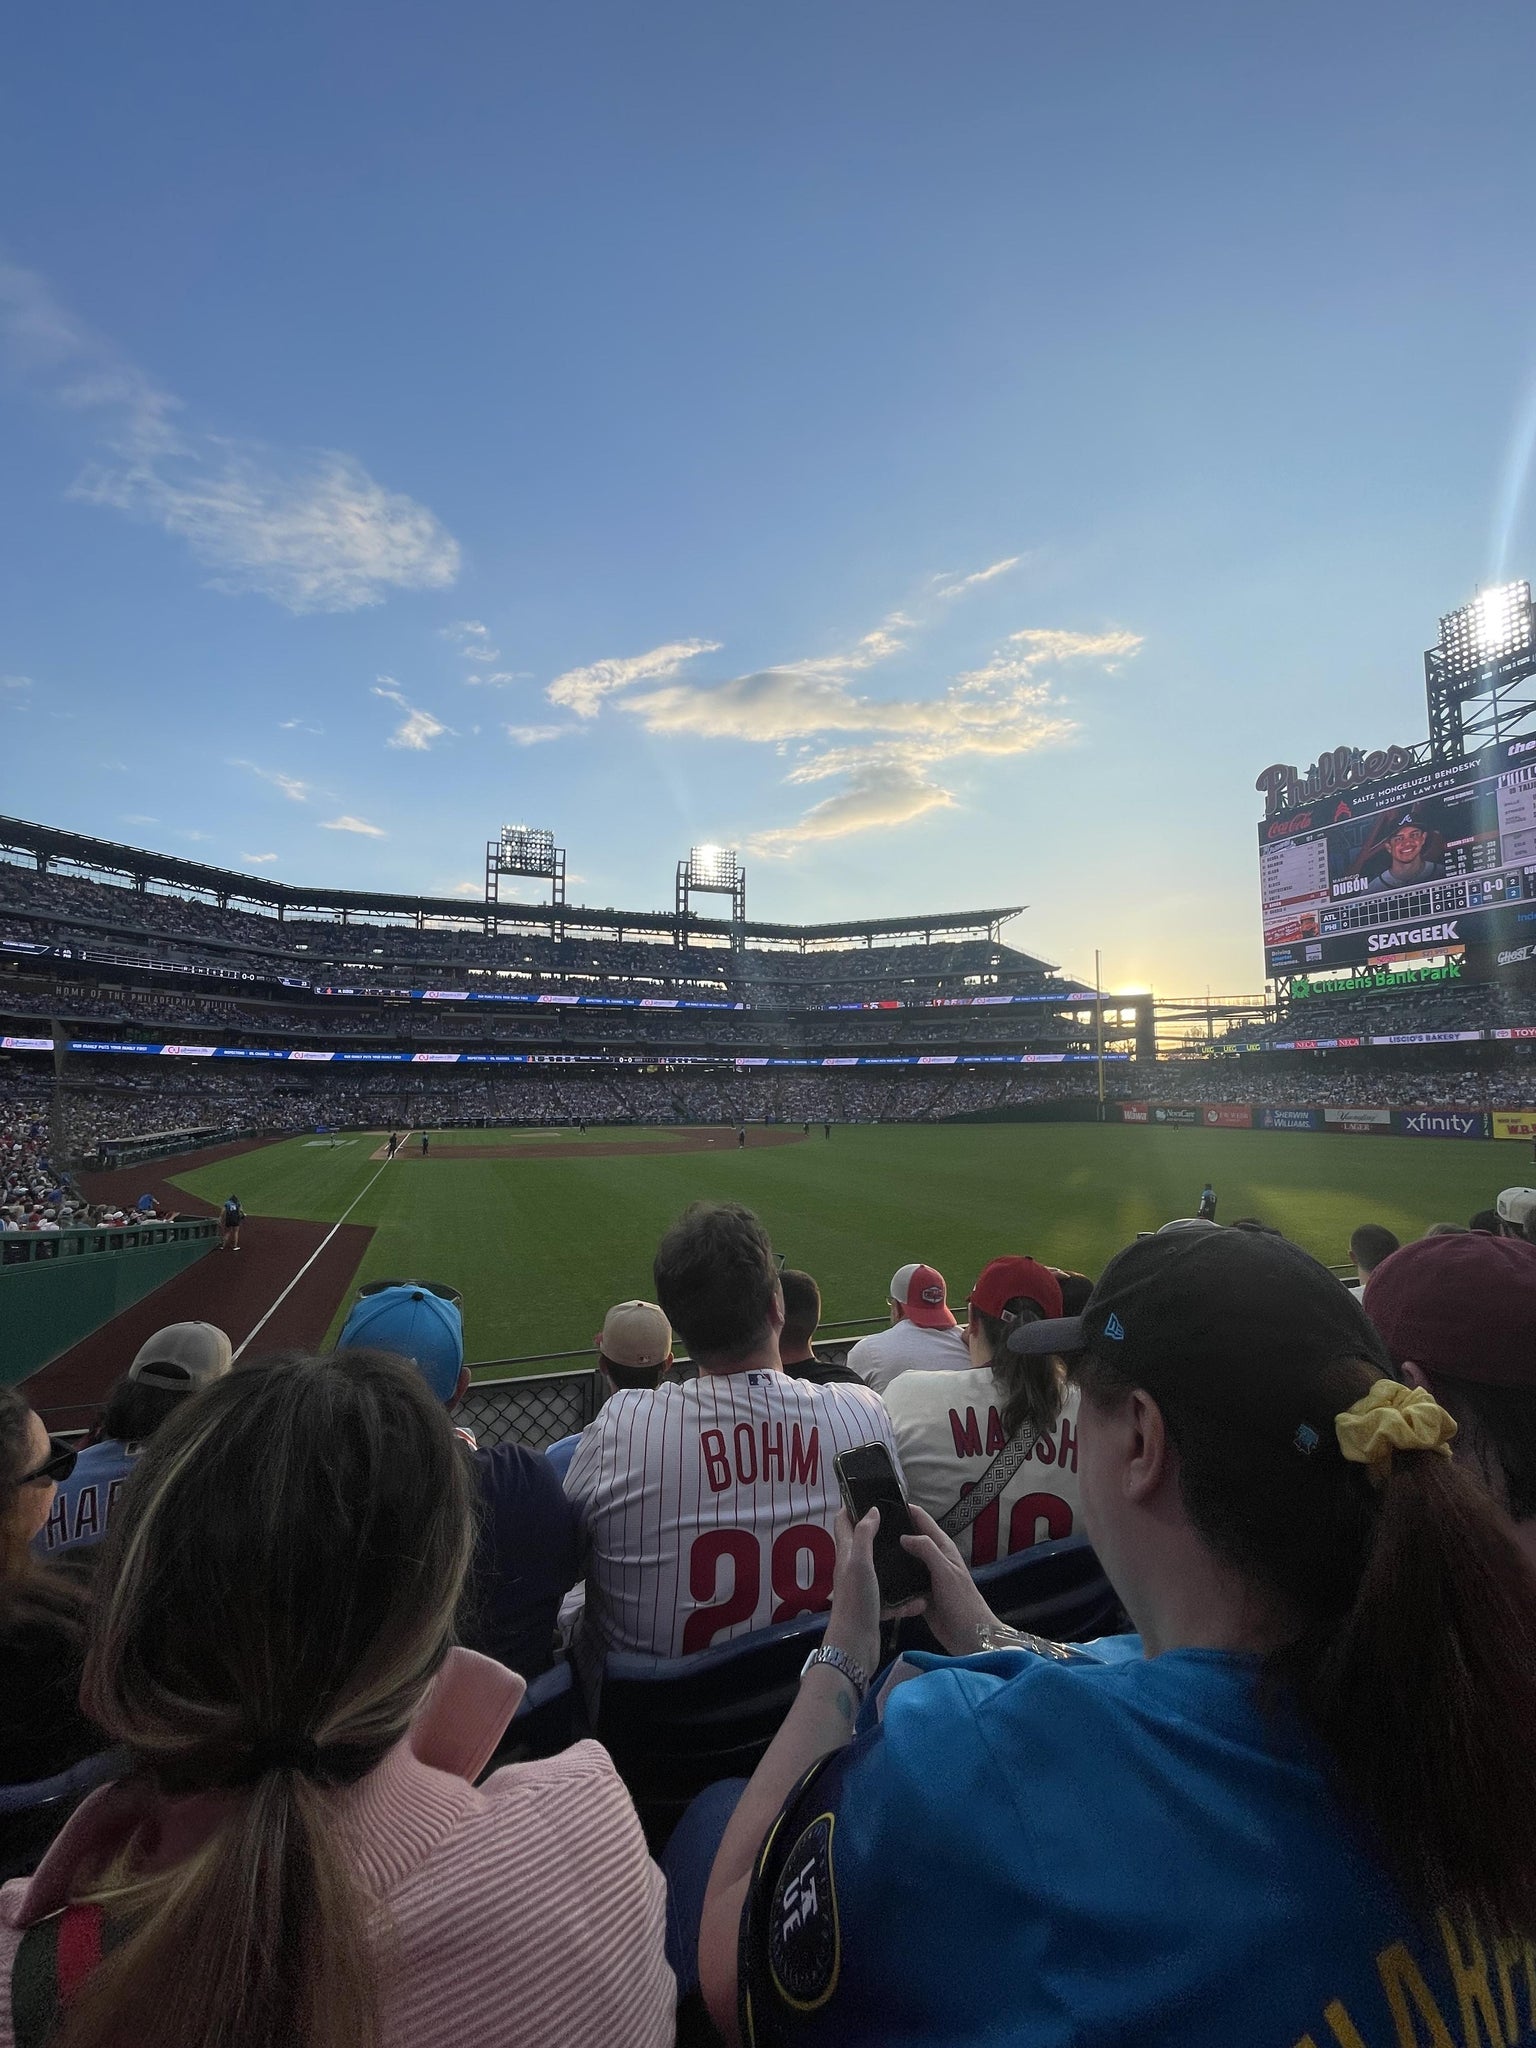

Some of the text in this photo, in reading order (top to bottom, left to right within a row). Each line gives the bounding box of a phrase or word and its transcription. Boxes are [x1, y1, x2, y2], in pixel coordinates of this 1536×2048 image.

[1255, 744, 1410, 815] Phillies
[1352, 758, 1481, 806] SALTZ MONGELUZZI BENDESKY
[1375, 778, 1455, 807] INJURY LAWYERS
[1333, 877, 1368, 896] DUBÓN
[1323, 914, 1337, 922] ATL
[1325, 923, 1337, 932] PHI
[1368, 920, 1460, 952] SEATGEEK
[1497, 947, 1528, 964] GHOST
[1312, 963, 1462, 994] Citizens Bank Park
[55, 986, 237, 1010] HOME OF THE PHILADELPHIA PHILLIES
[1338, 1039, 1360, 1047] NECA
[1426, 1033, 1460, 1041] BAKERY
[1123, 1110, 1147, 1120] Wawa
[1274, 1111, 1309, 1119] SHERWIN
[1406, 1112, 1473, 1133] xfinity
[1343, 1123, 1370, 1131] LAGER
[948, 1405, 1080, 1475] MASH
[700, 1420, 819, 1492] BOHM
[681, 1524, 836, 1657] 28
